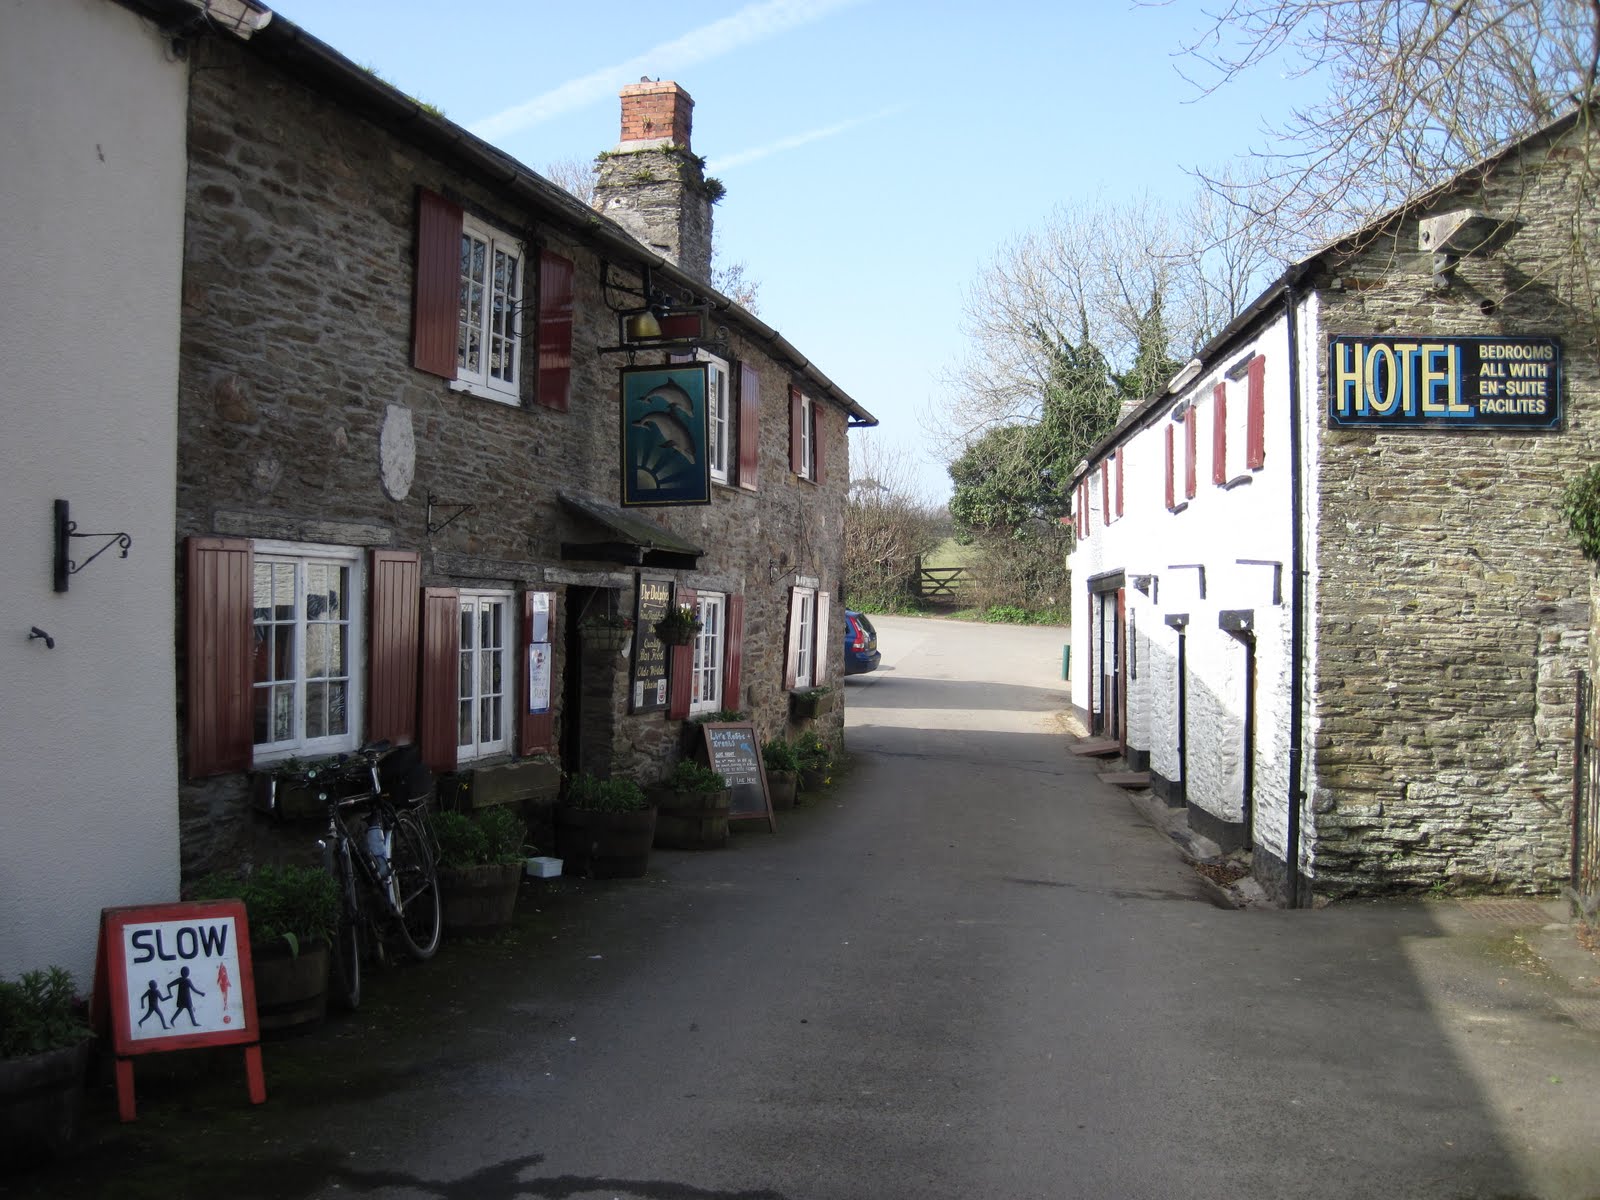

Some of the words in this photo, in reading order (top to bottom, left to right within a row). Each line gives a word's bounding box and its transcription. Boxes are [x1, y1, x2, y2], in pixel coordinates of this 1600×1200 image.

[1479, 345, 1553, 361] BEDROOMS
[1479, 363, 1506, 378] ALL
[1510, 363, 1548, 378] WITH
[1336, 343, 1471, 414] HOTEL
[1479, 381, 1547, 396] EN-SUITE
[1479, 399, 1547, 414] FACILITES
[131, 924, 228, 964] SLOW
